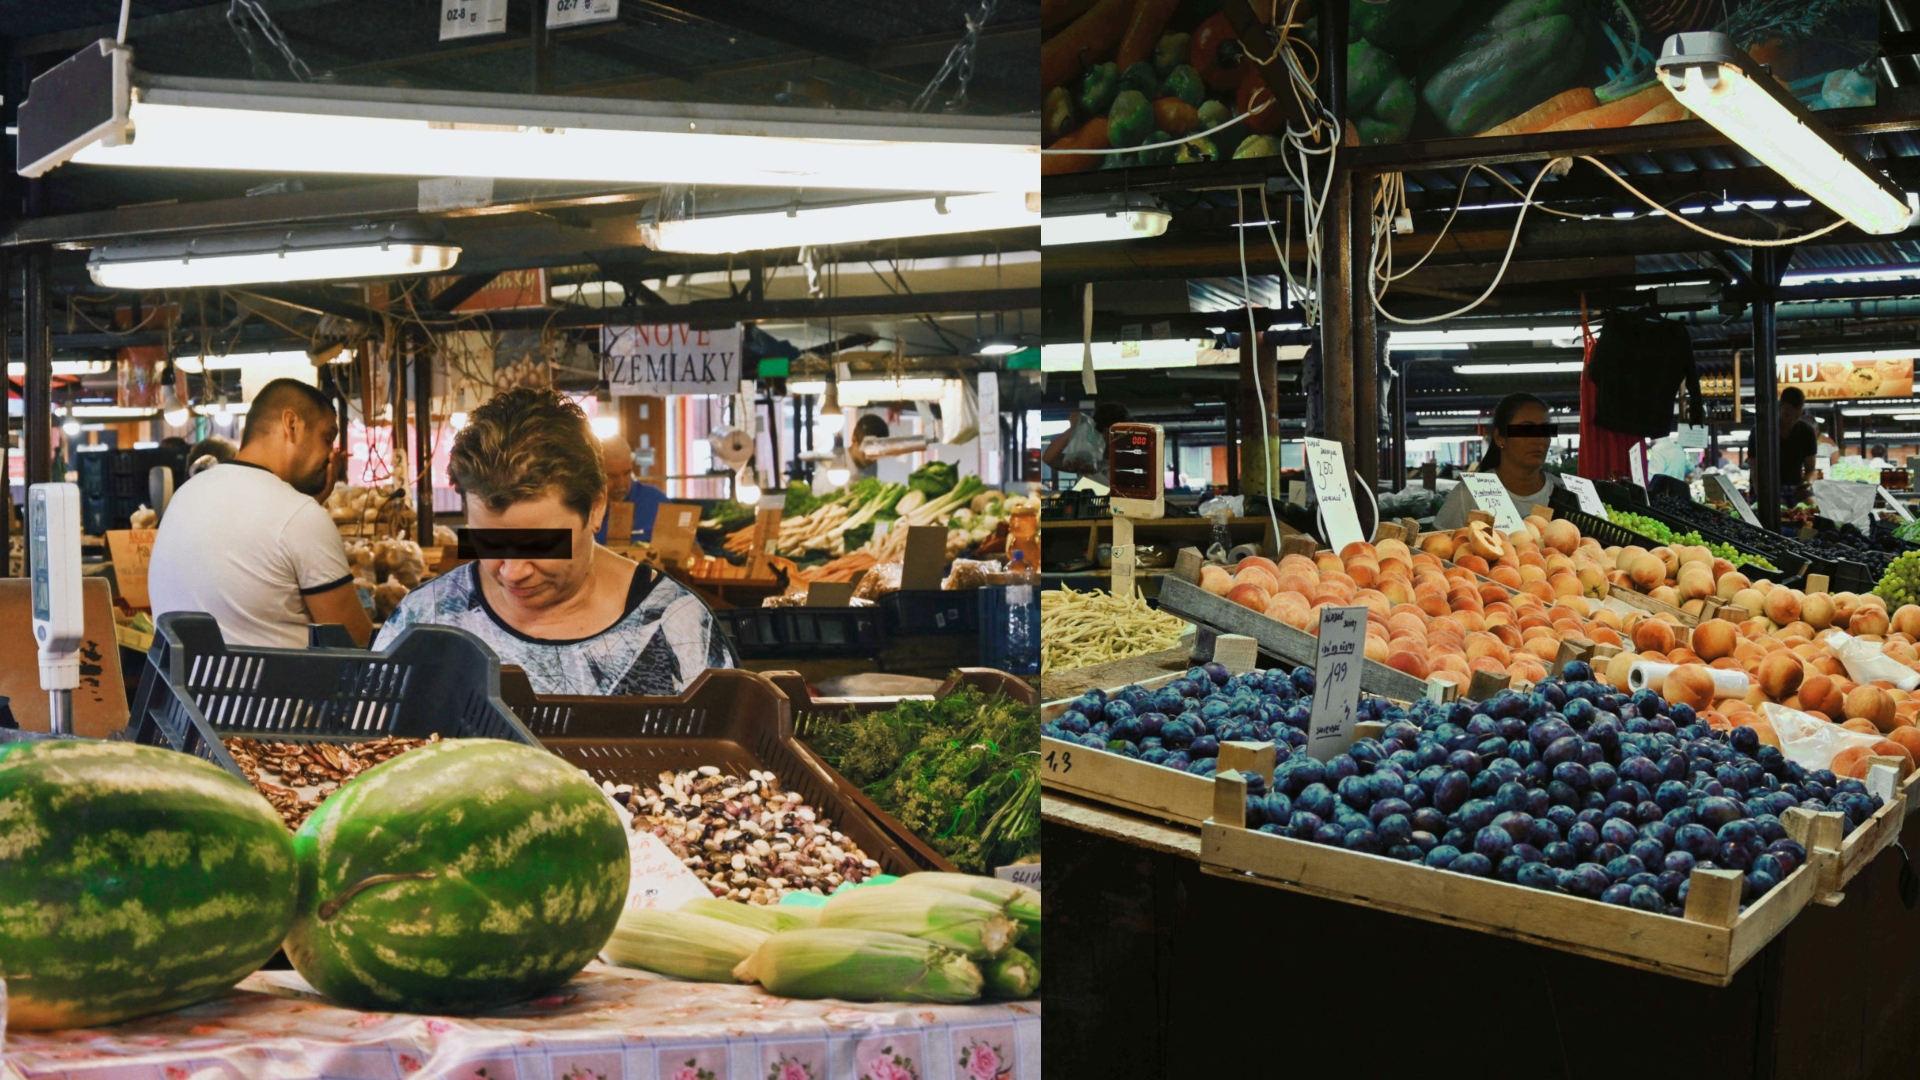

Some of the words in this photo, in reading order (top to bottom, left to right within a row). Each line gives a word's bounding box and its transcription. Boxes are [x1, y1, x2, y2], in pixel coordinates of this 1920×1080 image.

[446, 8, 466, 21] OZ-8
[612, 352, 734, 383] ZEMIAKY
[1045, 751, 1073, 774] 1,3
